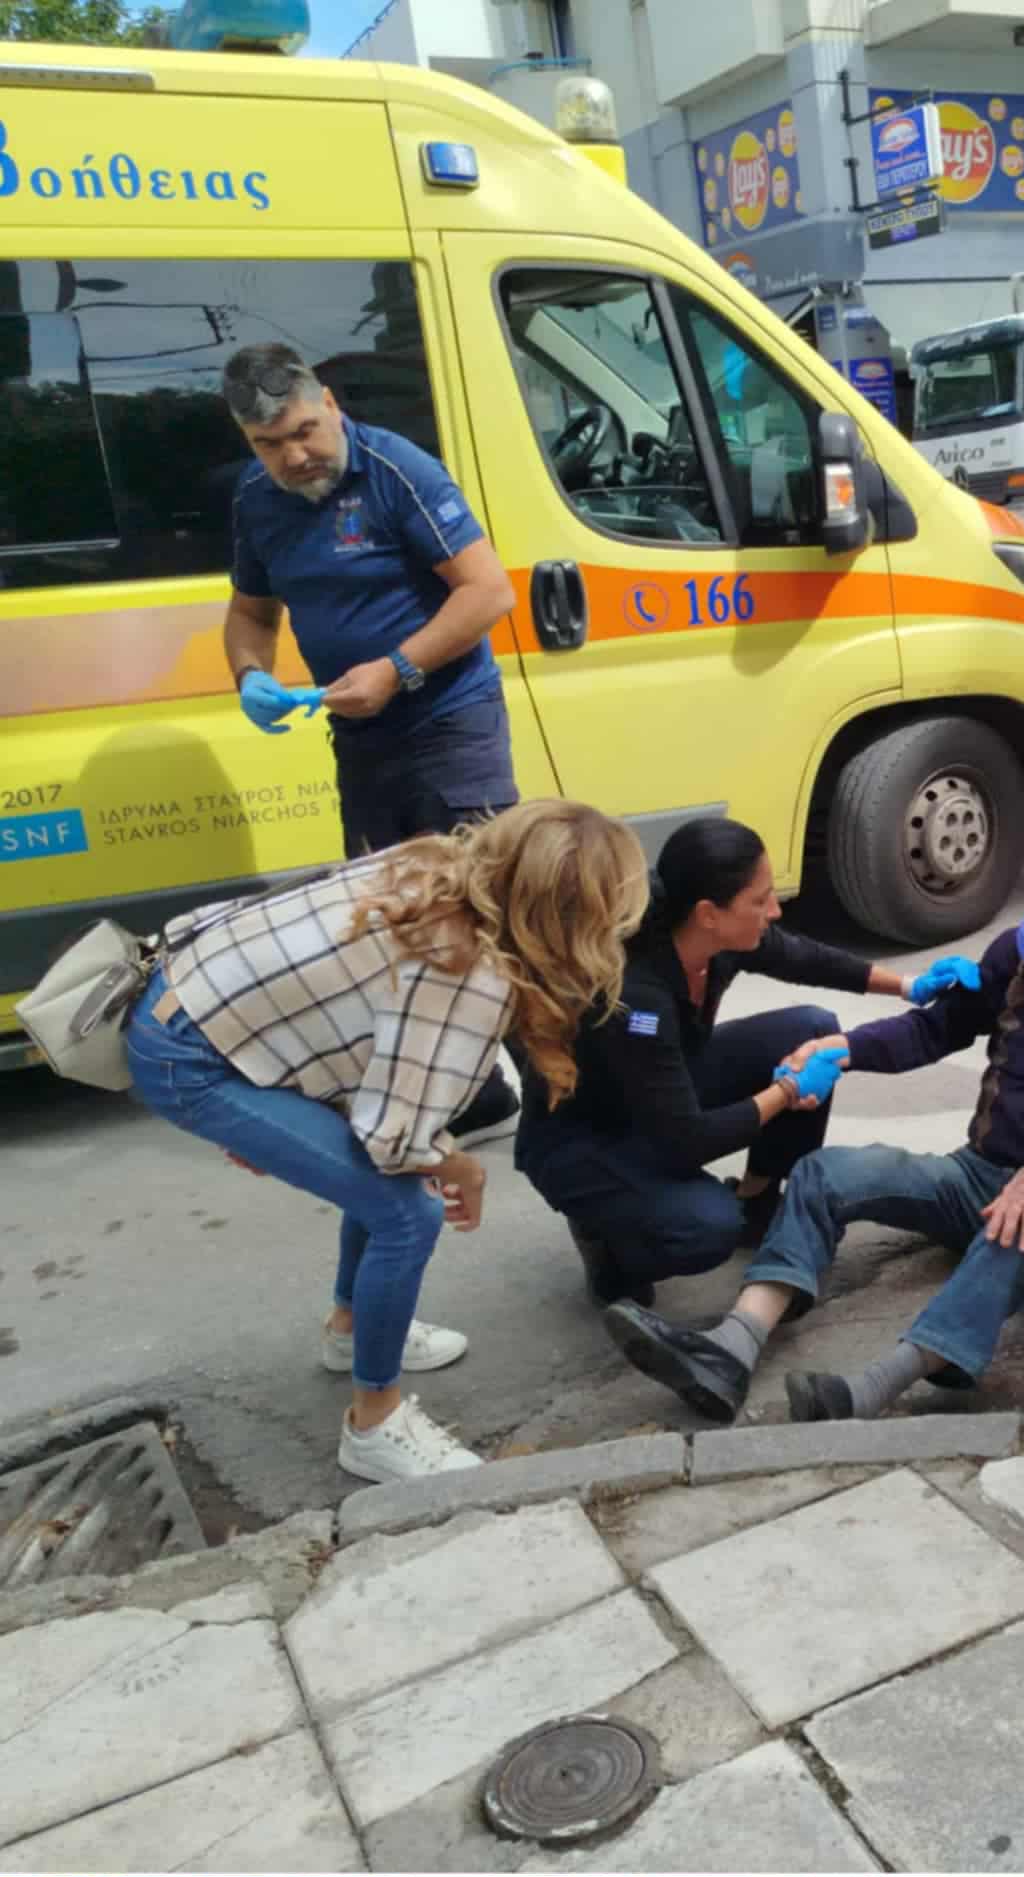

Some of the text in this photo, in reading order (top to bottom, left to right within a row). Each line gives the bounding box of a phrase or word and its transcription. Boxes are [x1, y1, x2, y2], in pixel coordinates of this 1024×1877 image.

[940, 128, 989, 181] ay's
[683, 572, 755, 625] 166
[1, 783, 63, 809] 2017
[98, 779, 337, 825] ΙΔΡΥΜΑ ΣΤΑΥΡΟΣ ΝΙΑ
[103, 820, 201, 846] STAVROS
[213, 800, 321, 832] NIARCHOS
